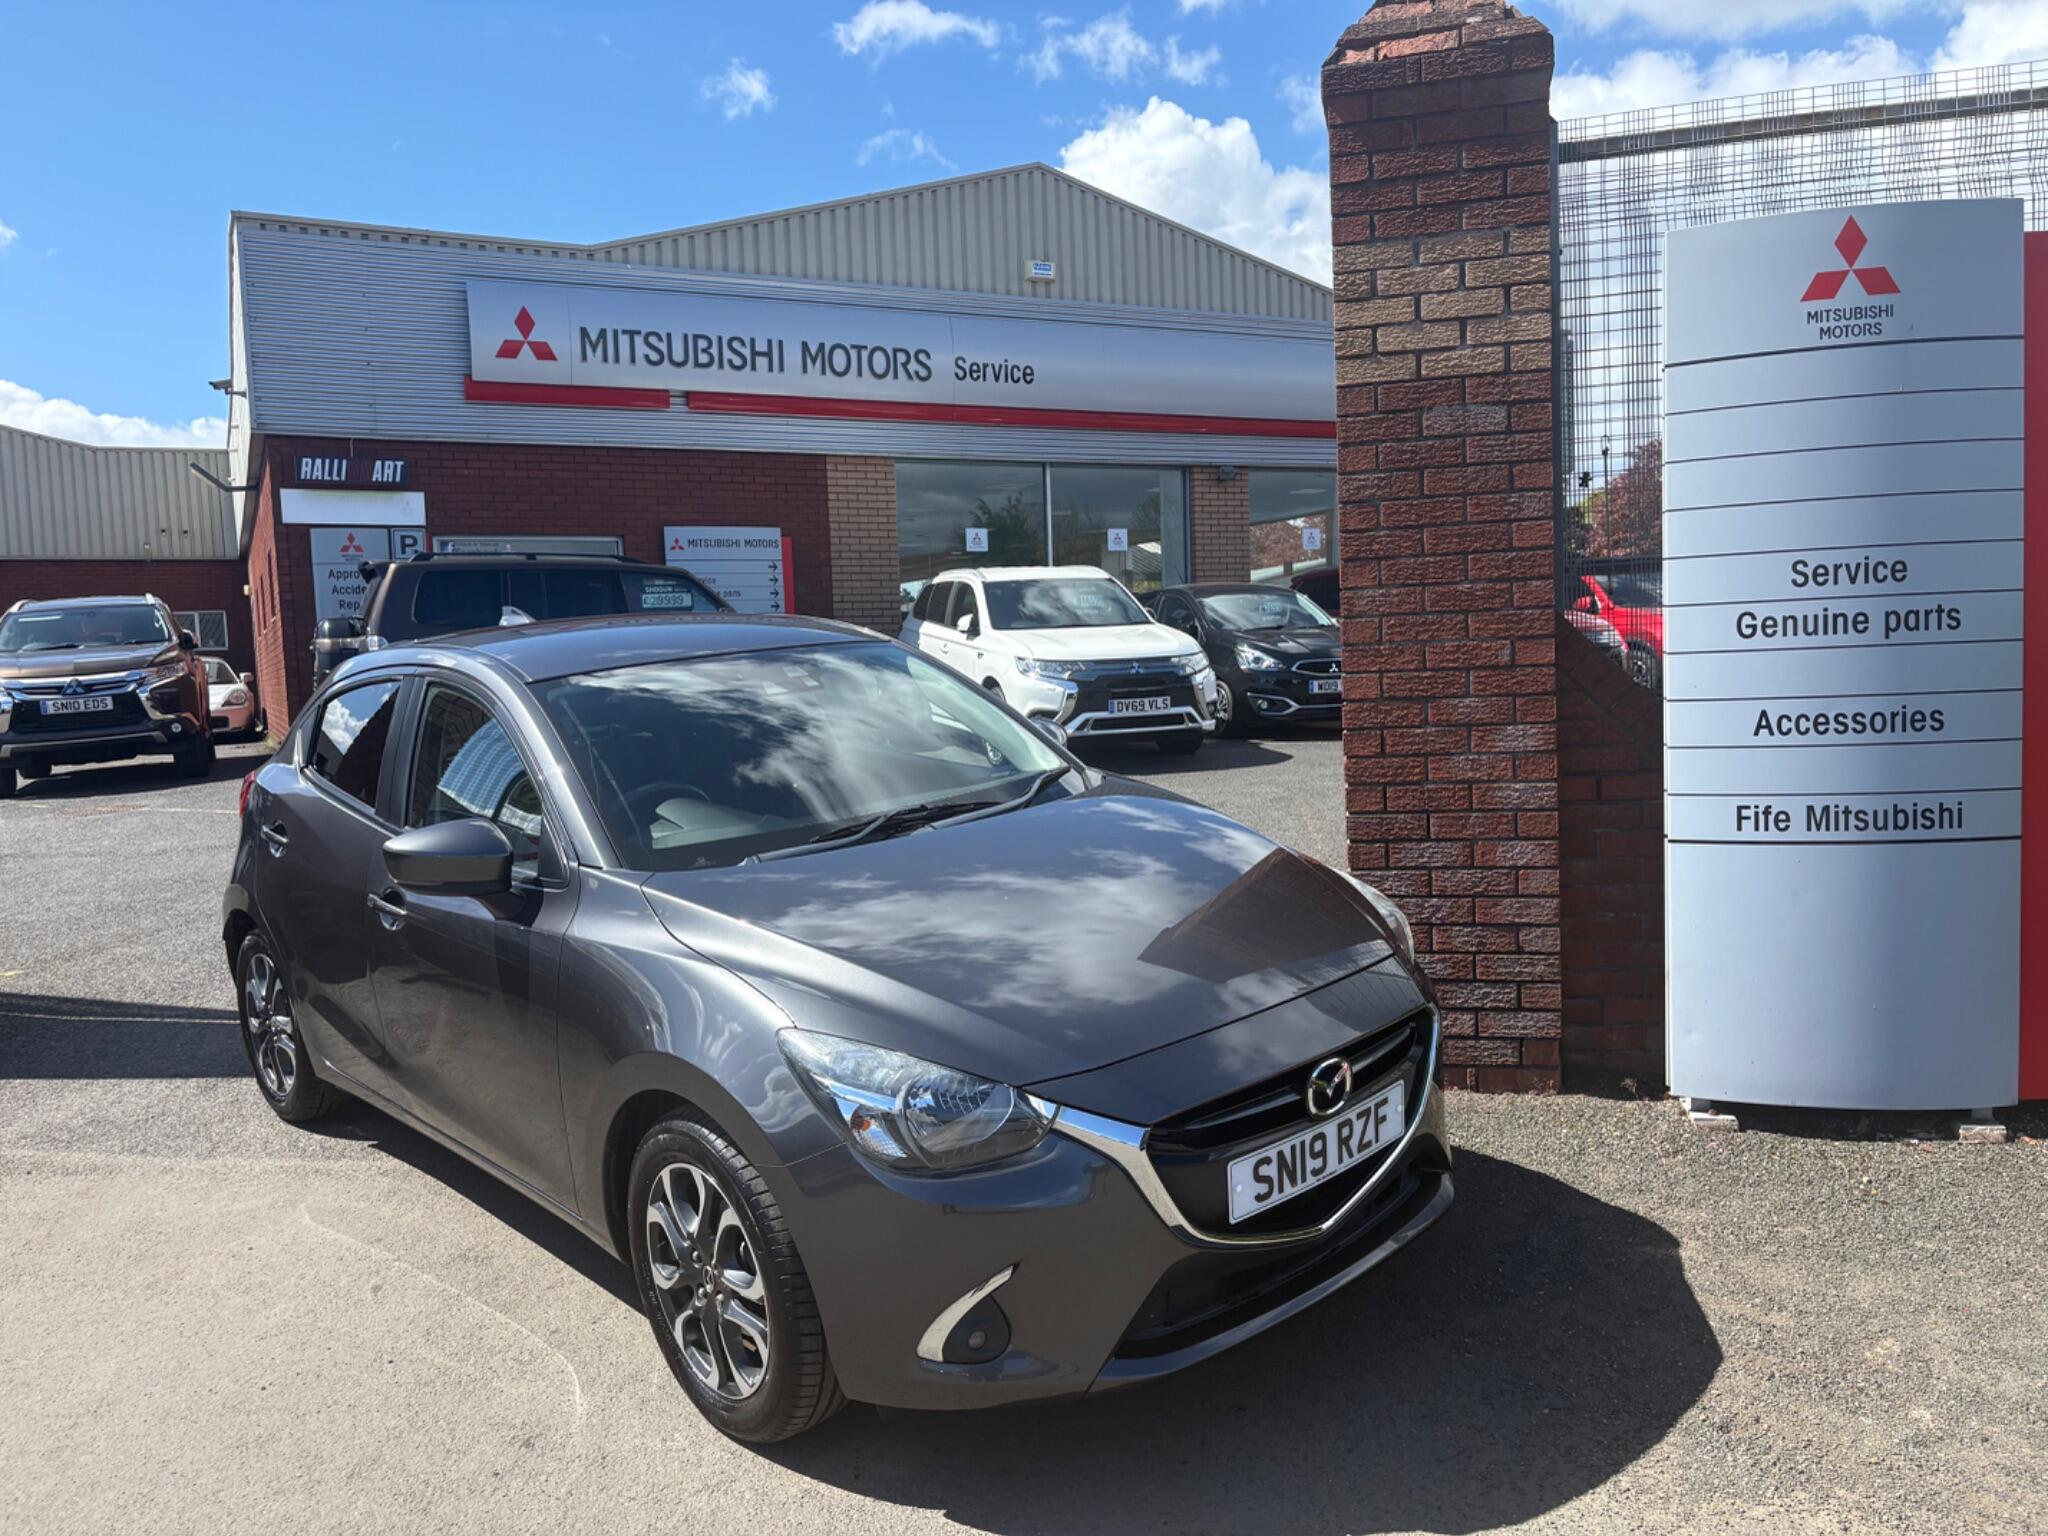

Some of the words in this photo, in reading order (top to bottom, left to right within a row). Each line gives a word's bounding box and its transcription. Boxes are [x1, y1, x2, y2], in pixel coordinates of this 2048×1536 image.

[1807, 303, 1894, 325] MITSUBISHI
[1819, 322, 1883, 340] MOTORS
[579, 325, 785, 374] MITSUBISHI
[800, 341, 933, 382] MOTORS
[953, 355, 1035, 385] Service
[300, 458, 347, 481] RALLI
[372, 460, 404, 483] ART
[400, 535, 418, 555] P
[687, 538, 741, 549] MITSUBISHI
[744, 539, 779, 549] MOTORS
[328, 568, 361, 581] Appro
[1791, 556, 1908, 588] Service
[331, 583, 367, 595] Accide
[1736, 608, 1869, 639] Genuine
[1884, 604, 1961, 639] parts
[84, 698, 108, 709] EDS
[1117, 700, 1145, 712] DV69
[1148, 698, 1169, 710] VLS
[1753, 705, 1945, 737] Accessories
[1736, 804, 1791, 832] Fife
[1805, 801, 1964, 832] Mitsubishi
[1252, 1132, 1328, 1203] SN19
[1337, 1097, 1389, 1166] RZF
